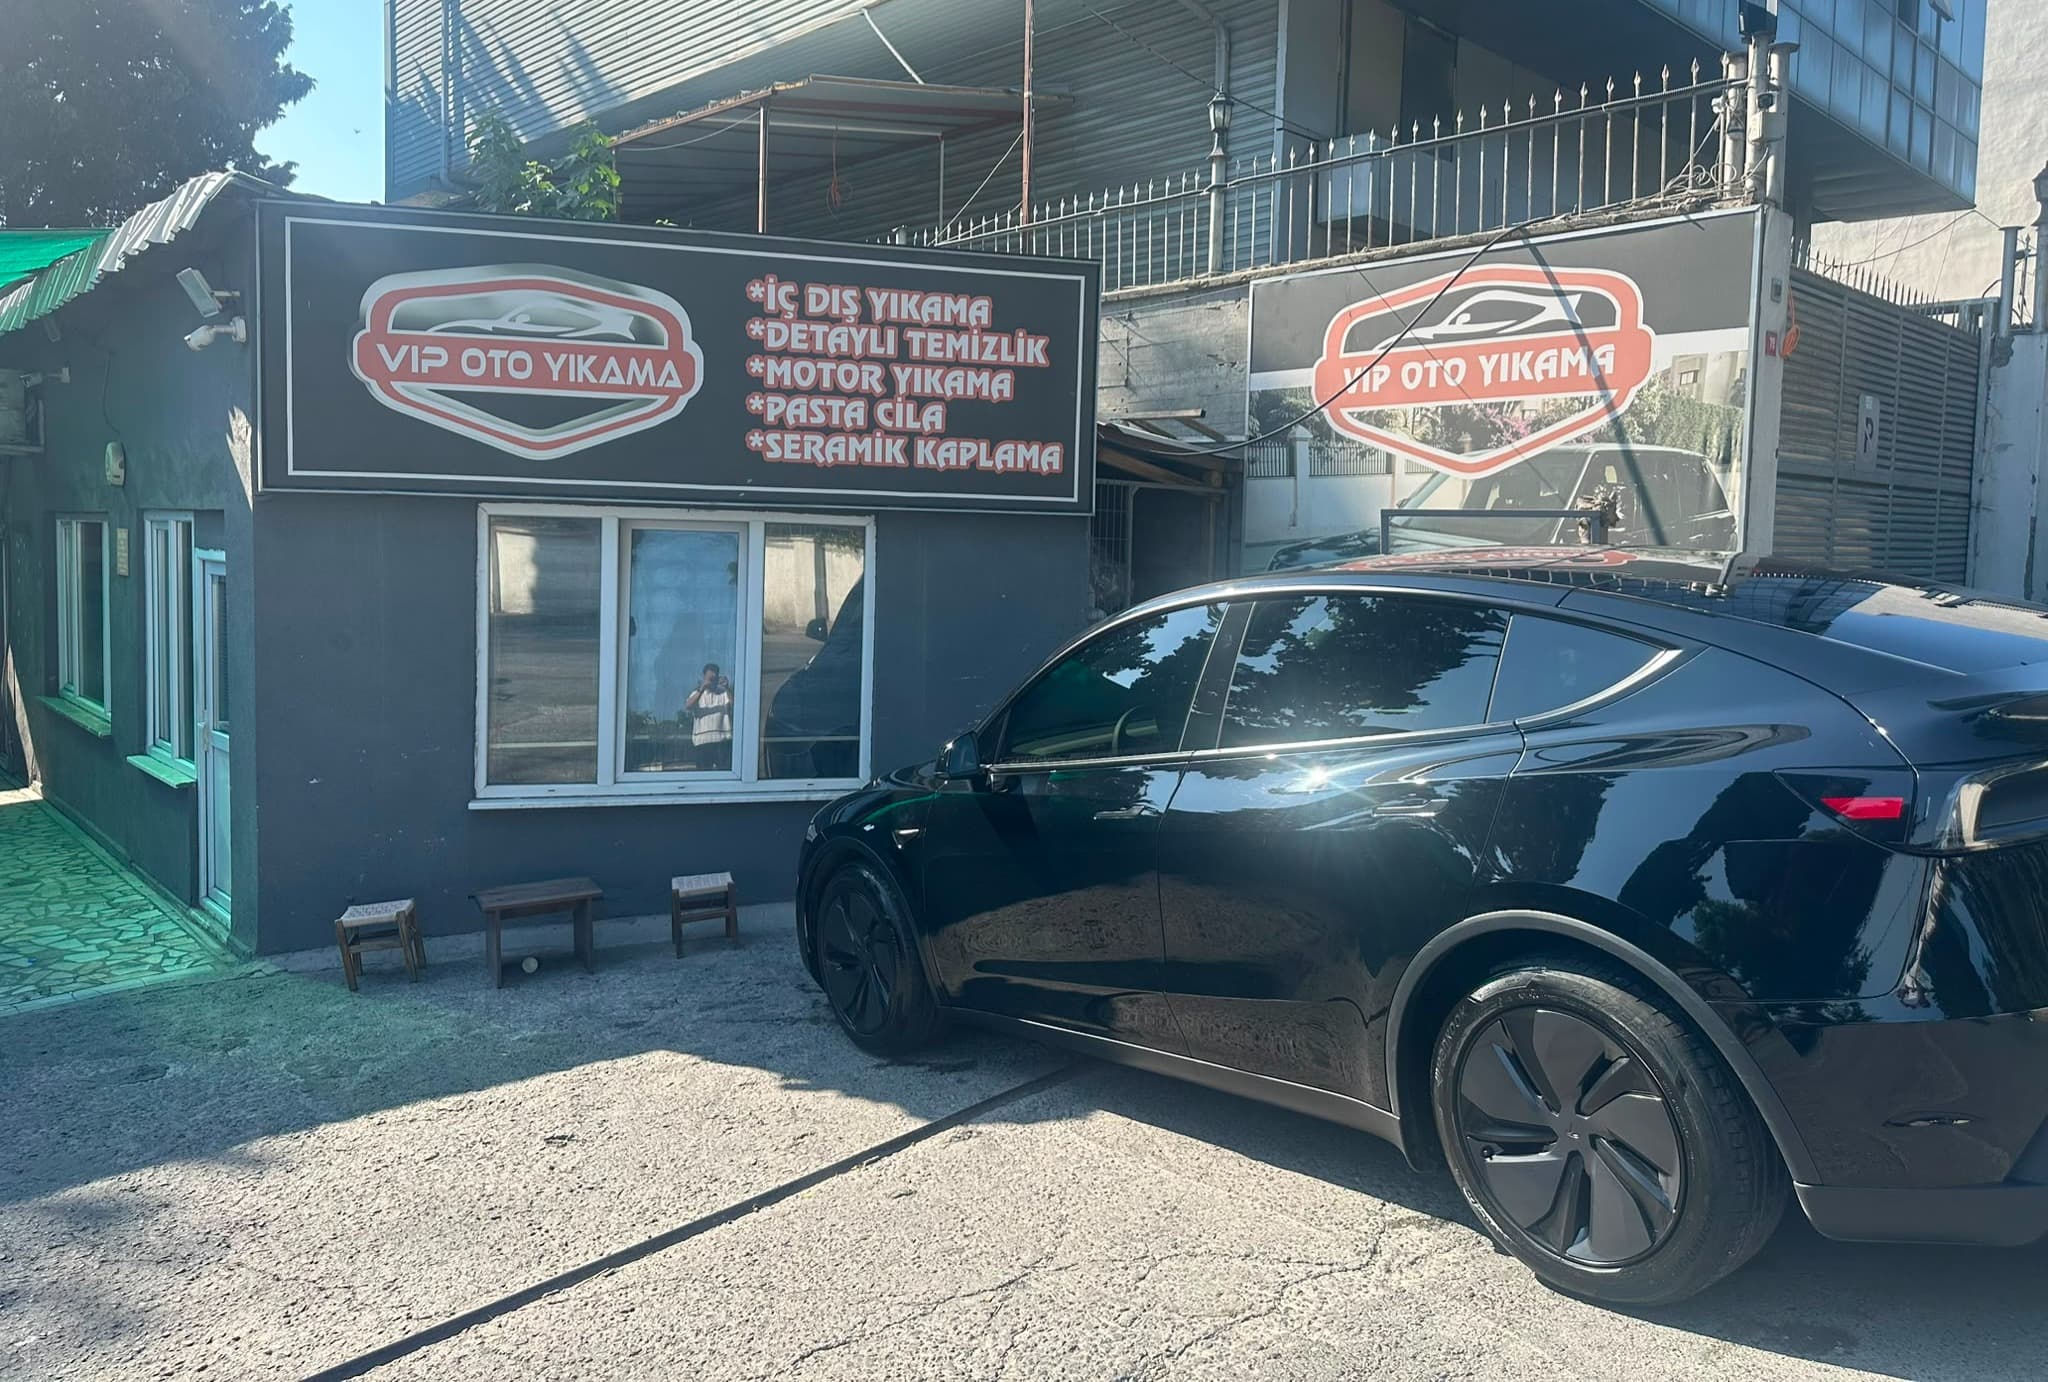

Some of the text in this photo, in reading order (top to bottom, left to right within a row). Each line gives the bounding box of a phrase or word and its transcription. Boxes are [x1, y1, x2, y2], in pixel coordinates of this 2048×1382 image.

[805, 284, 860, 324] DIŞ
[867, 289, 992, 327] YIKAMA
[376, 343, 684, 389] VIP OTO YIKAMA
[905, 328, 1049, 366] TEMİZLİK
[892, 364, 1014, 400] YIKAMA
[1343, 343, 1616, 395] VIP OTO YIKAMA
[875, 397, 947, 433] CİLA
[916, 440, 1064, 473] KAPLAMA
